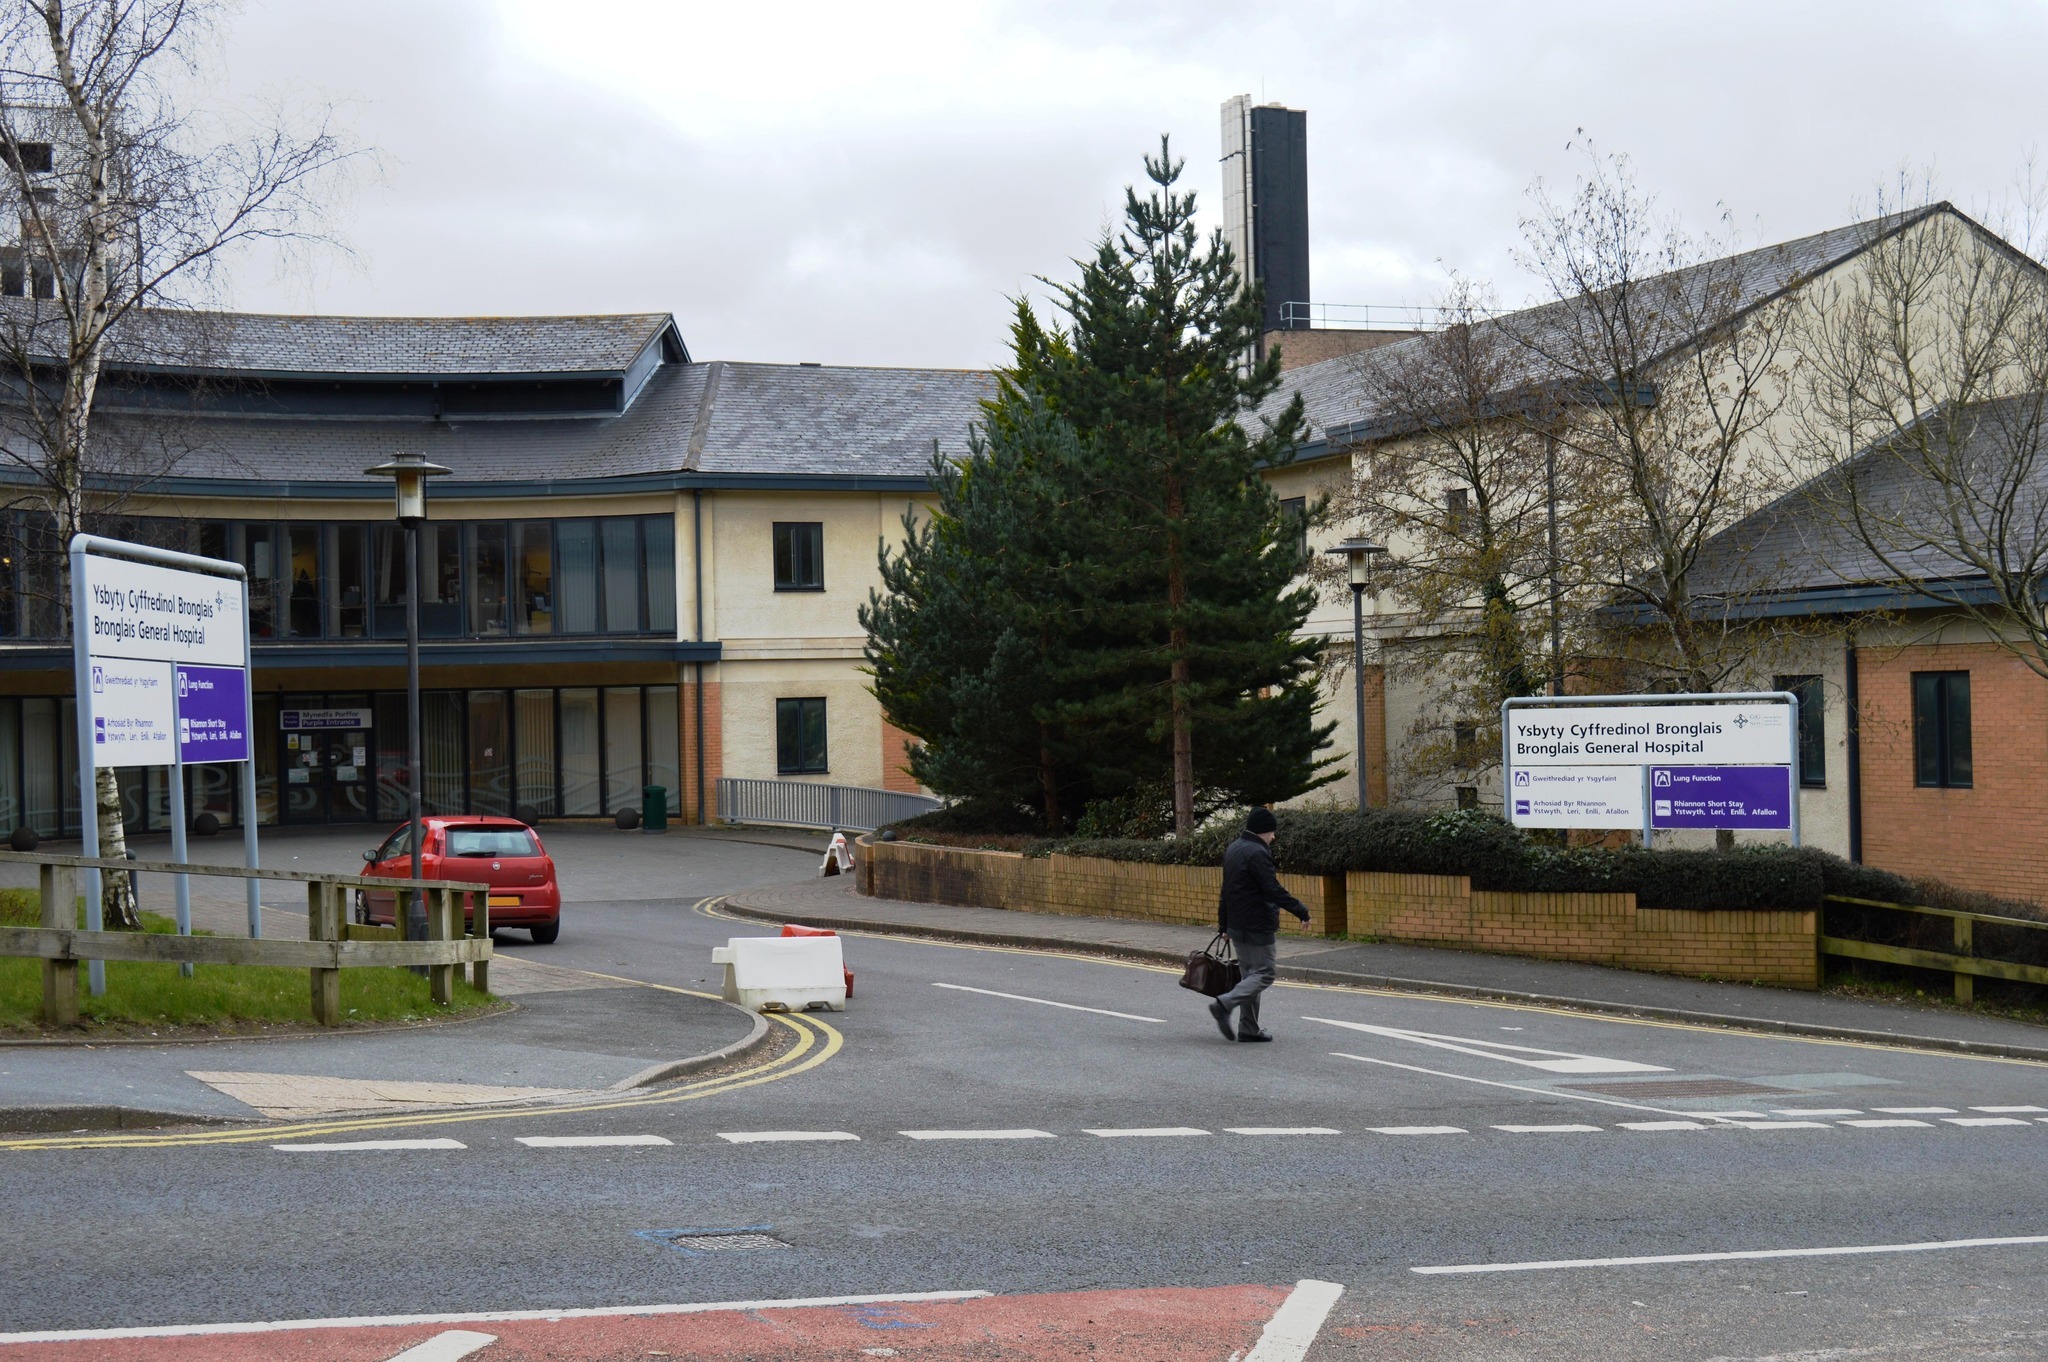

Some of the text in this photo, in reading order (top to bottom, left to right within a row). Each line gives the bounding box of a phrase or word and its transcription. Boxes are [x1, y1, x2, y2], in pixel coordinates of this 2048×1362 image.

[93, 584, 125, 612] Ysbyty
[129, 590, 176, 615] Cyffredinol
[179, 597, 213, 621] Bronglais
[94, 616, 205, 648] Bronglais General Hospital
[188, 680, 214, 690] Lung Function
[190, 720, 226, 729] Rhiannon Short Stay
[1518, 722, 1722, 739] Ysbyty Cyffredinol Bronglais
[1517, 741, 1703, 757] Bronglais General Hospital
[1586, 775, 1617, 784] Ysgyfaint
[1674, 774, 1721, 783] Lung Function
[1564, 800, 1574, 808] Byr
[1728, 800, 1744, 809] Stay
[1534, 808, 1562, 816] Ystwyth,
[1675, 808, 1705, 817] Ystwyth,
[1710, 808, 1725, 816] Leri,
[1731, 808, 1746, 816] Enlli,
